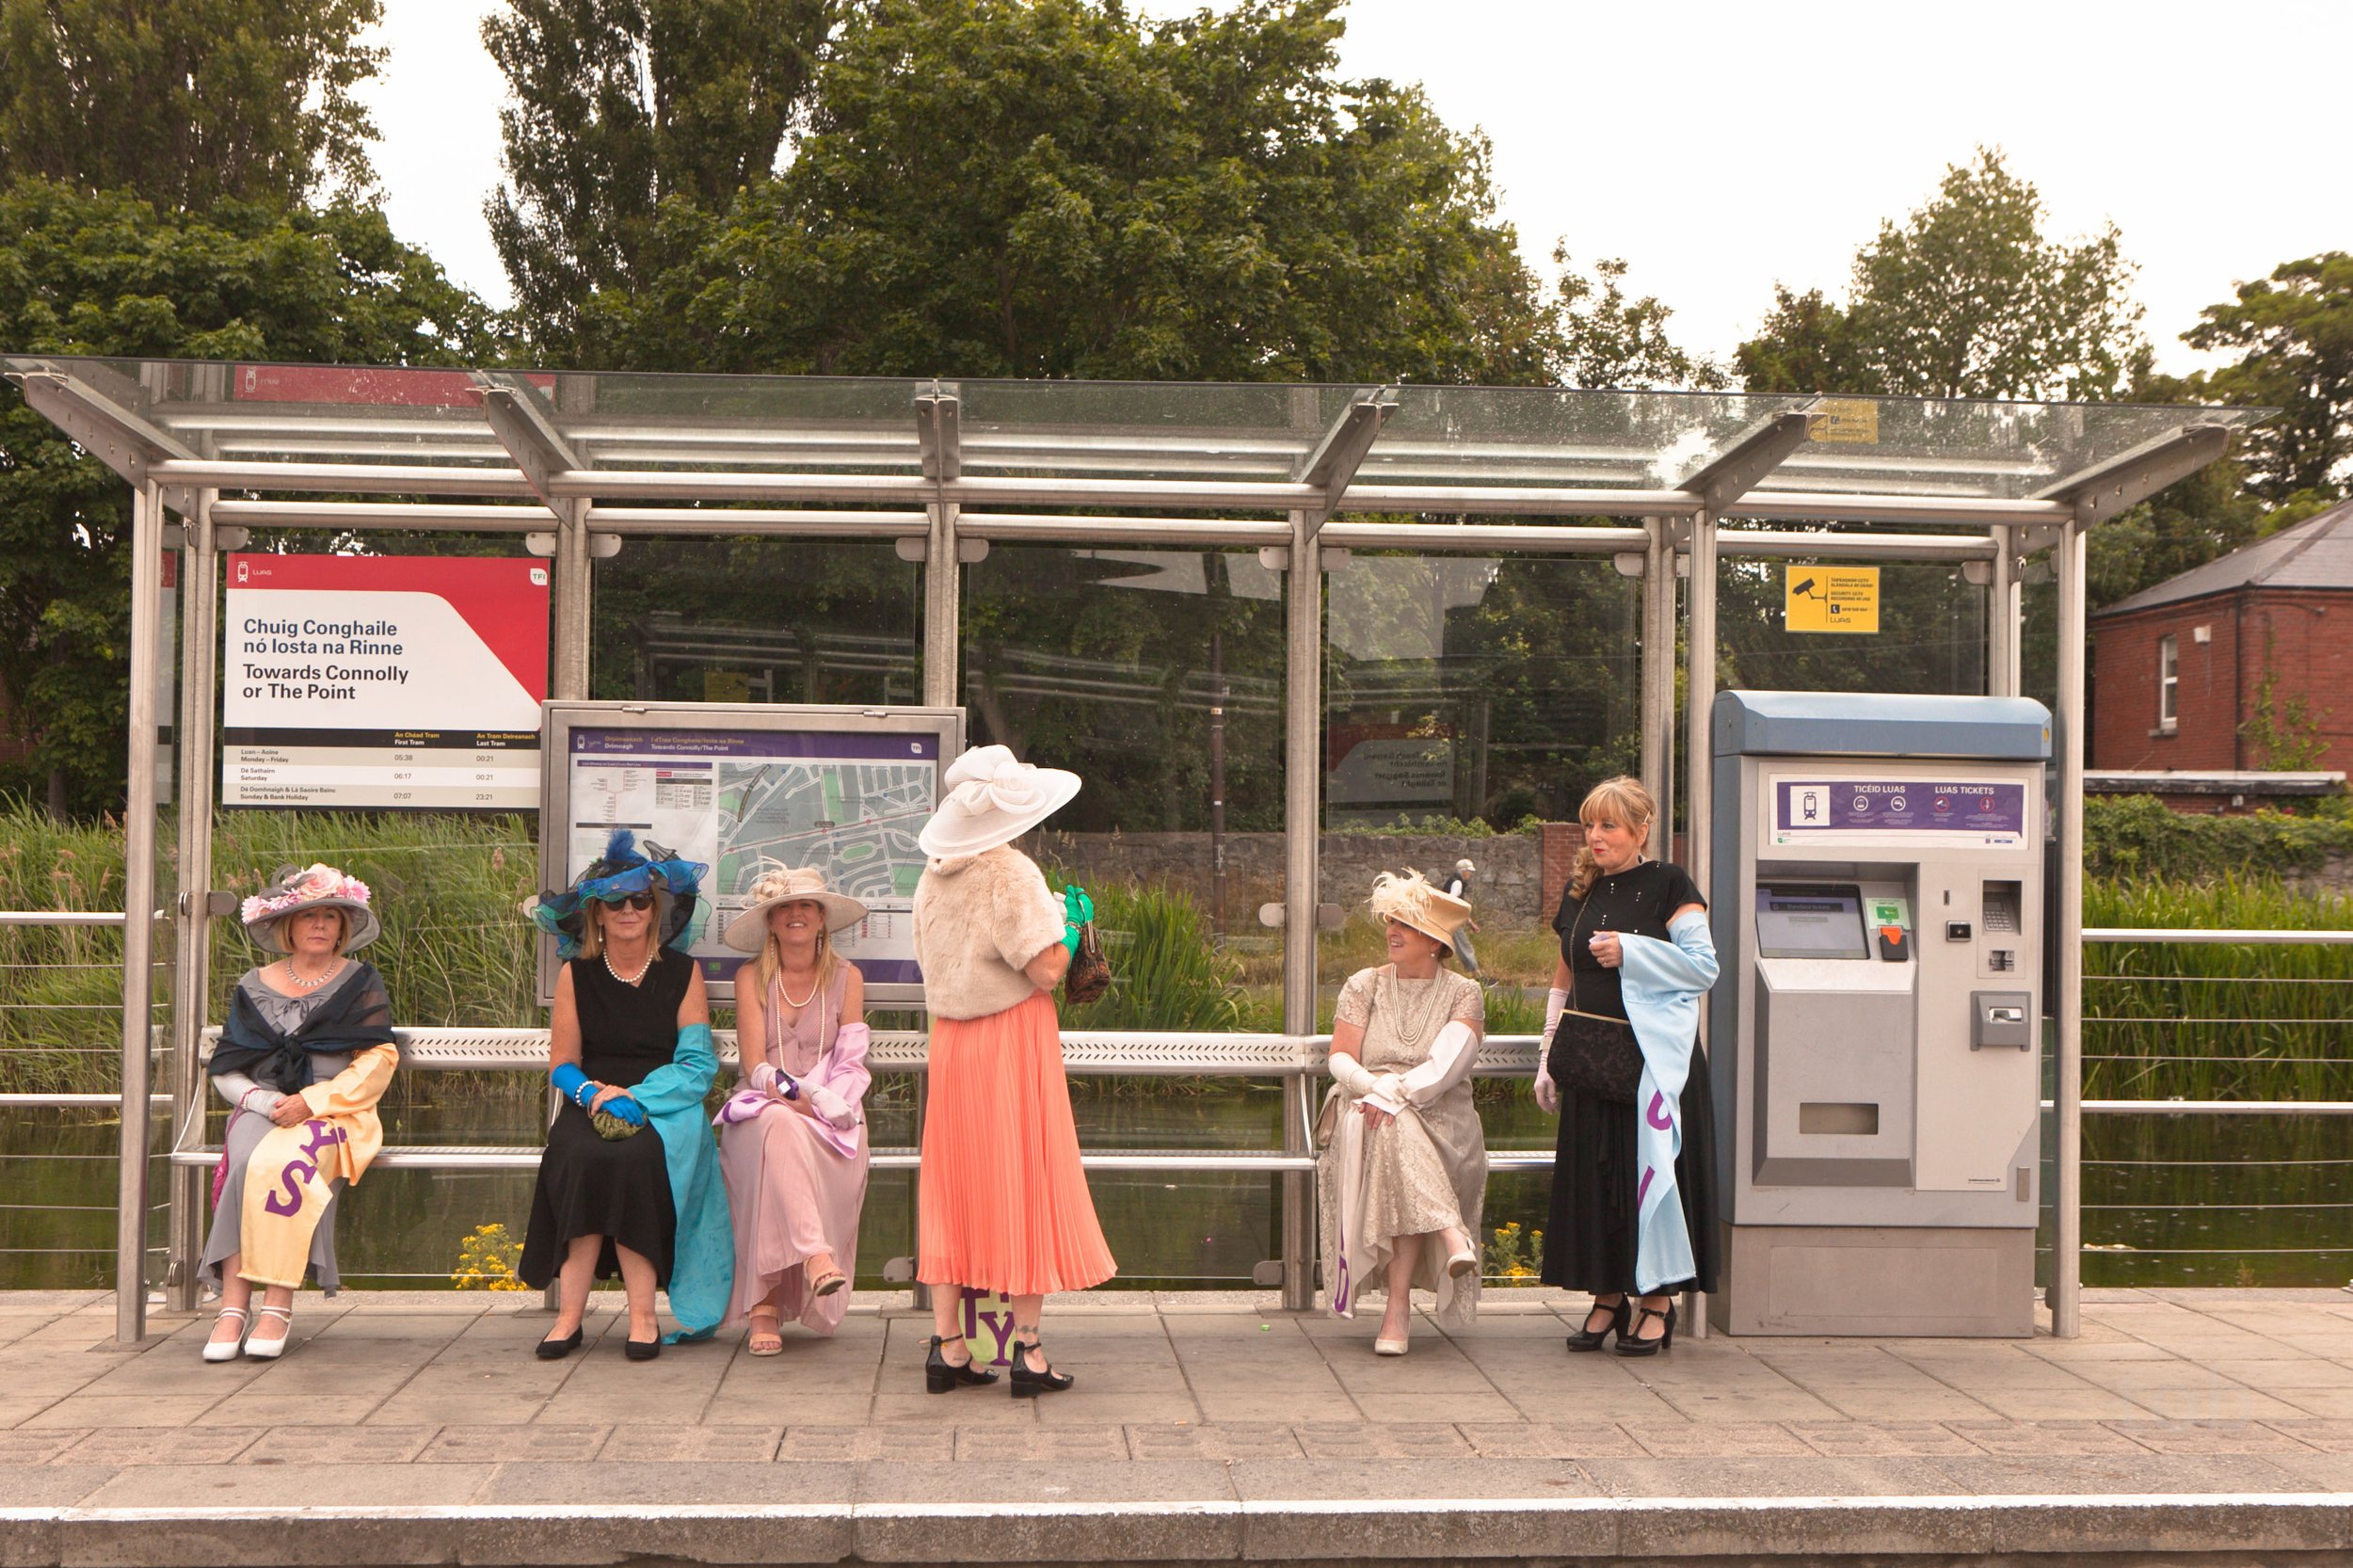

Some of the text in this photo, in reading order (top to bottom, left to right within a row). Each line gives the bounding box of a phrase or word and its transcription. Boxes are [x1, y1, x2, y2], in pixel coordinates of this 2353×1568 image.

[244, 618, 397, 639] Chuig Conghaile
[244, 637, 403, 655] nó Iosta na Rinne
[243, 664, 409, 685] Towards Connolly
[242, 683, 356, 699] or The Point
[1854, 784, 1881, 794] TICÉID
[1935, 786, 1994, 795] LUAS TICKETS
